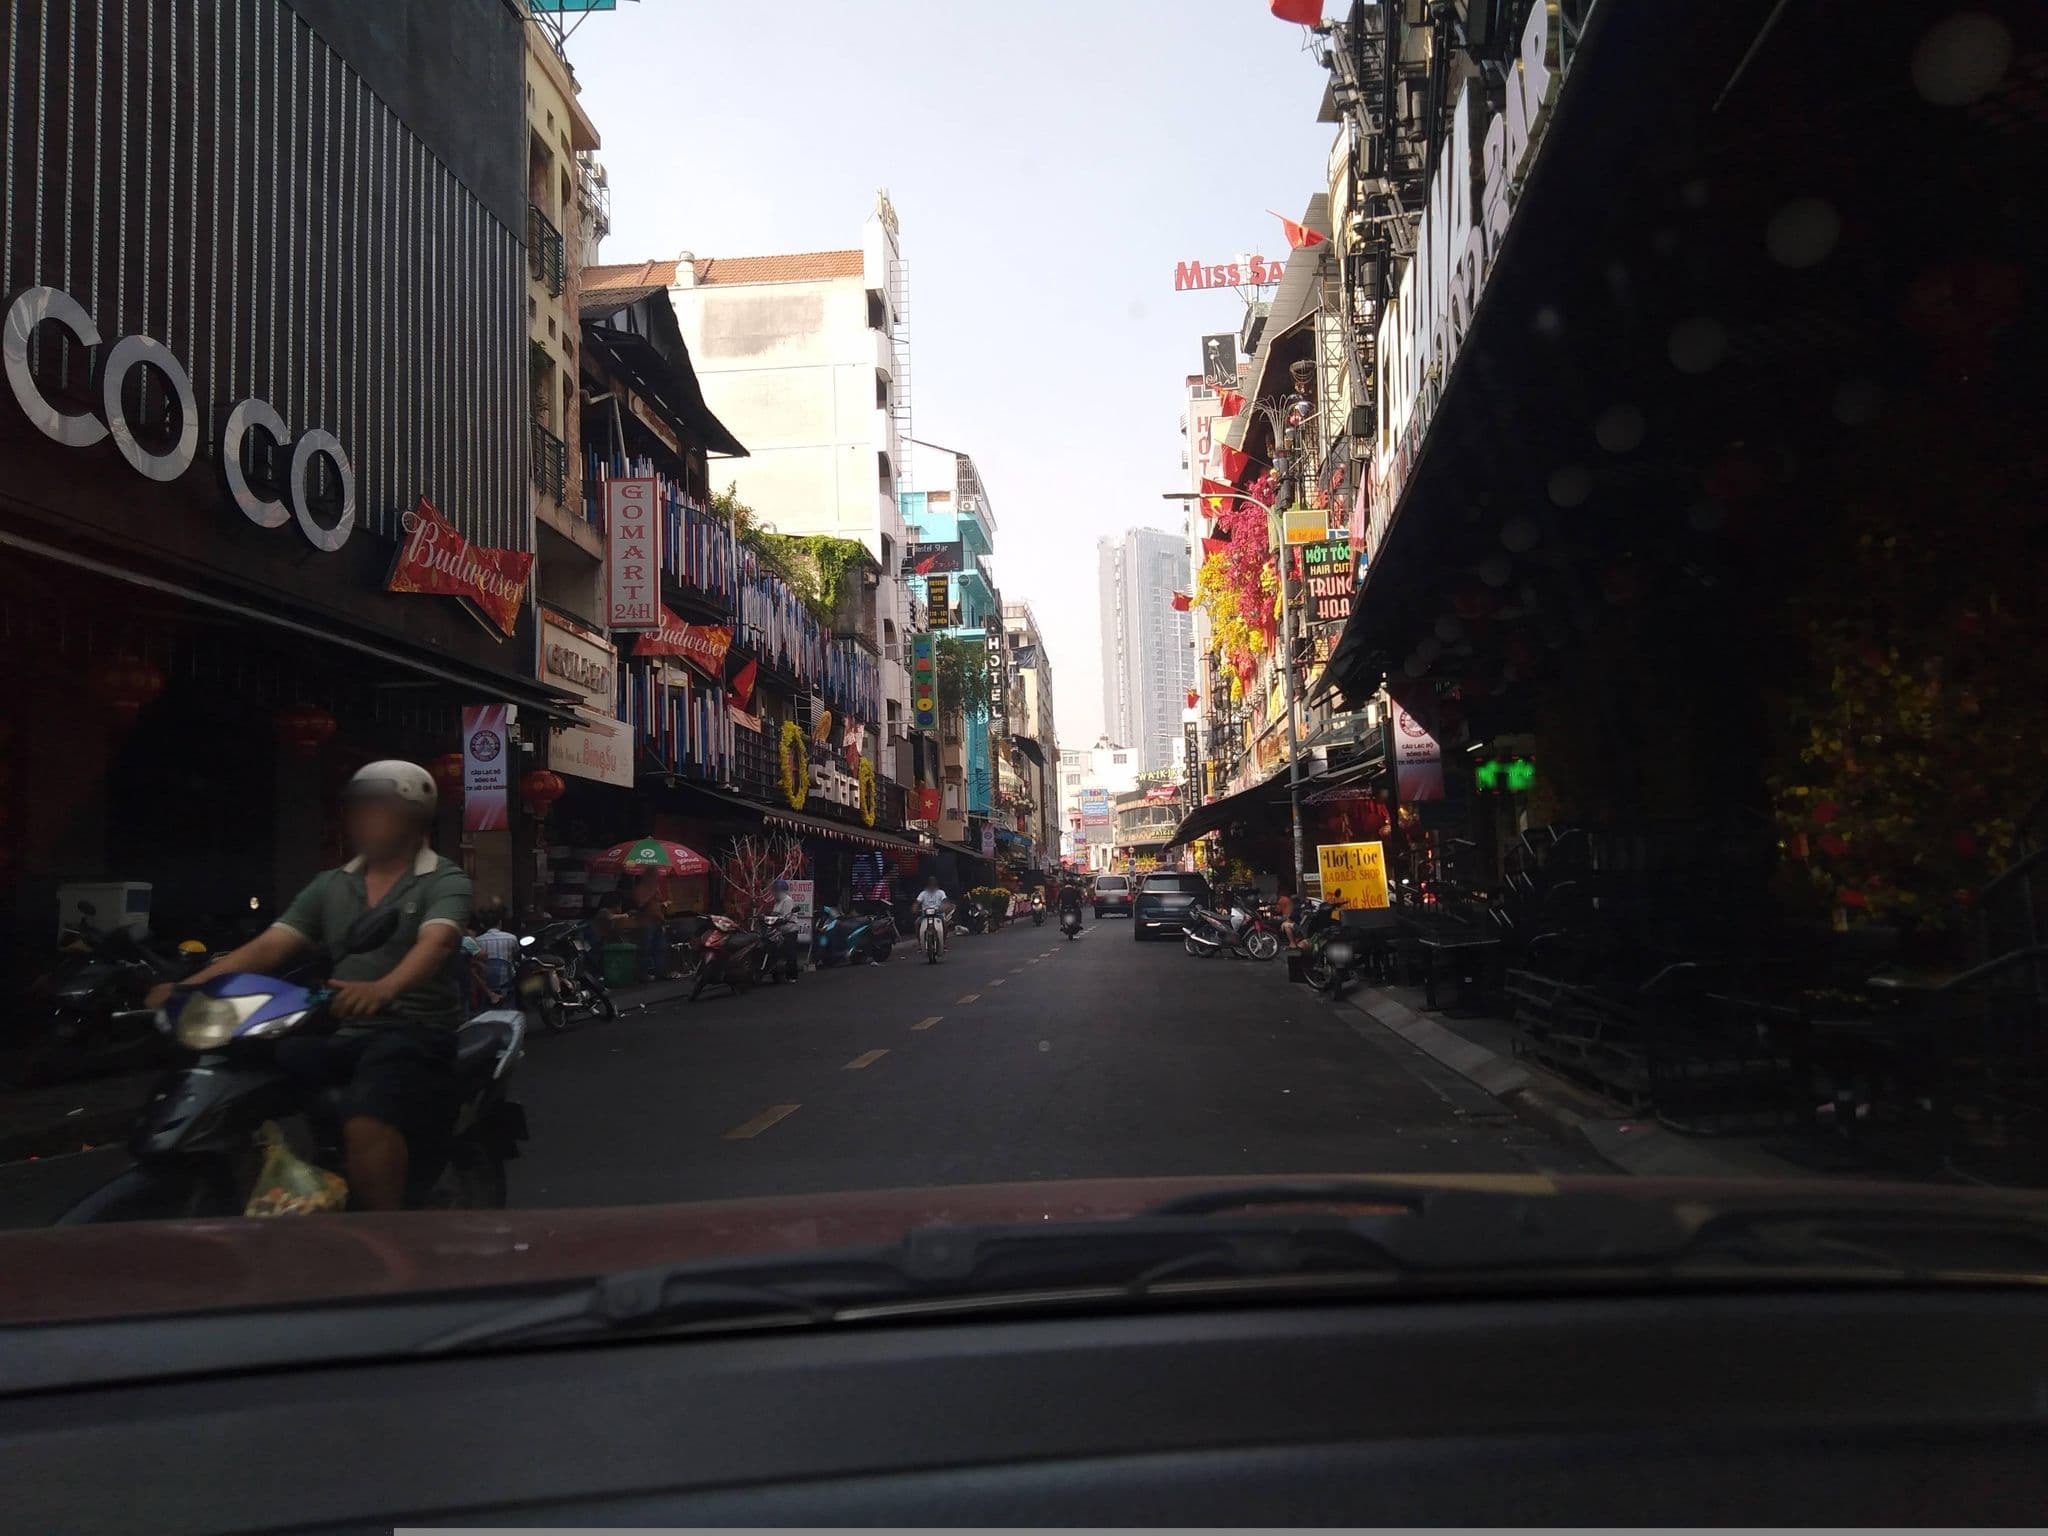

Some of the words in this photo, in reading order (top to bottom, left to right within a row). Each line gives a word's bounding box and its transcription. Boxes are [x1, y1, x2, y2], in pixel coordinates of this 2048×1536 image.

[1176, 260, 1241, 290] MISS
[402, 511, 526, 602] Budweiser
[618, 484, 647, 600] GOMART
[1310, 564, 1331, 576] HAIR
[1333, 563, 1350, 573] CUT
[614, 603, 651, 620] 24H
[1317, 598, 1350, 618] HOA
[646, 614, 728, 659] Budweiser
[915, 642, 935, 726] TATTOO
[988, 637, 1003, 719] HOTEL
